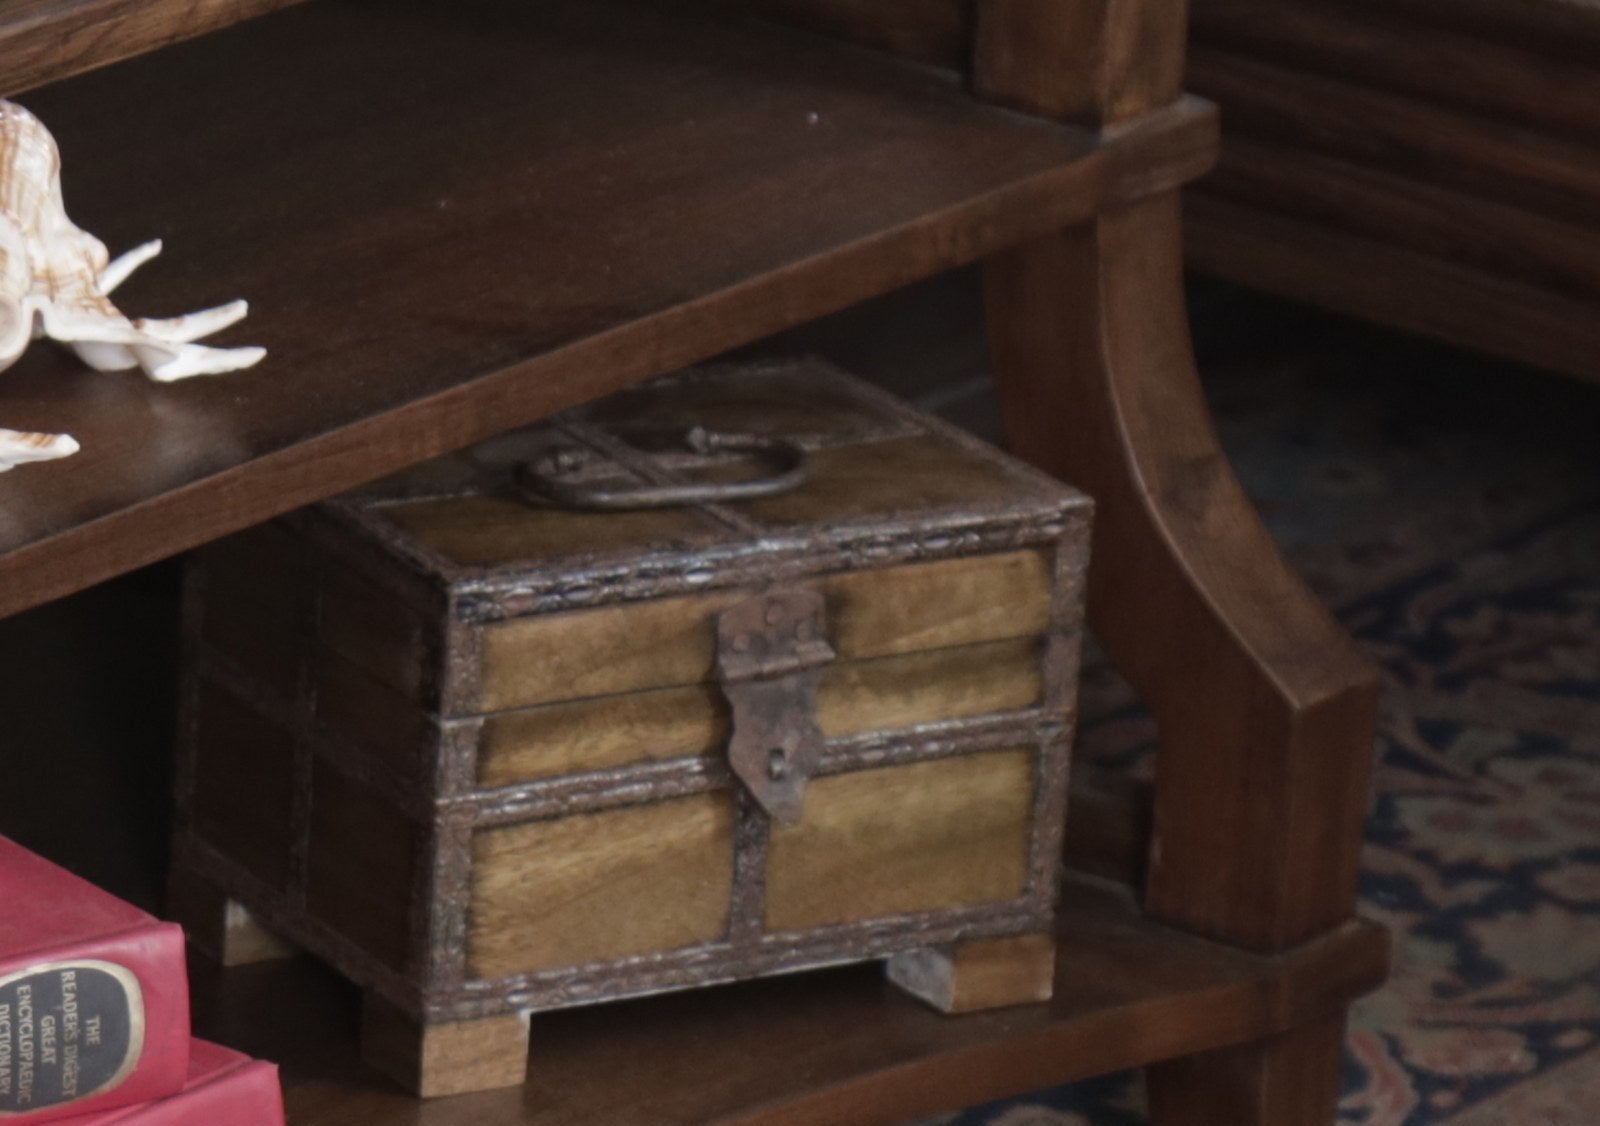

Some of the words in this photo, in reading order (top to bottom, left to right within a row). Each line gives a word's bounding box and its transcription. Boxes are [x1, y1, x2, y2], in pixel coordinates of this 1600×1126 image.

[61, 970, 80, 1042] READER'S
[85, 1015, 101, 1046] THE
[16, 984, 35, 1104] ENCYCLOPAEDIC
[40, 1015, 57, 1065] GREAT
[62, 1044, 80, 1097] DIGEST
